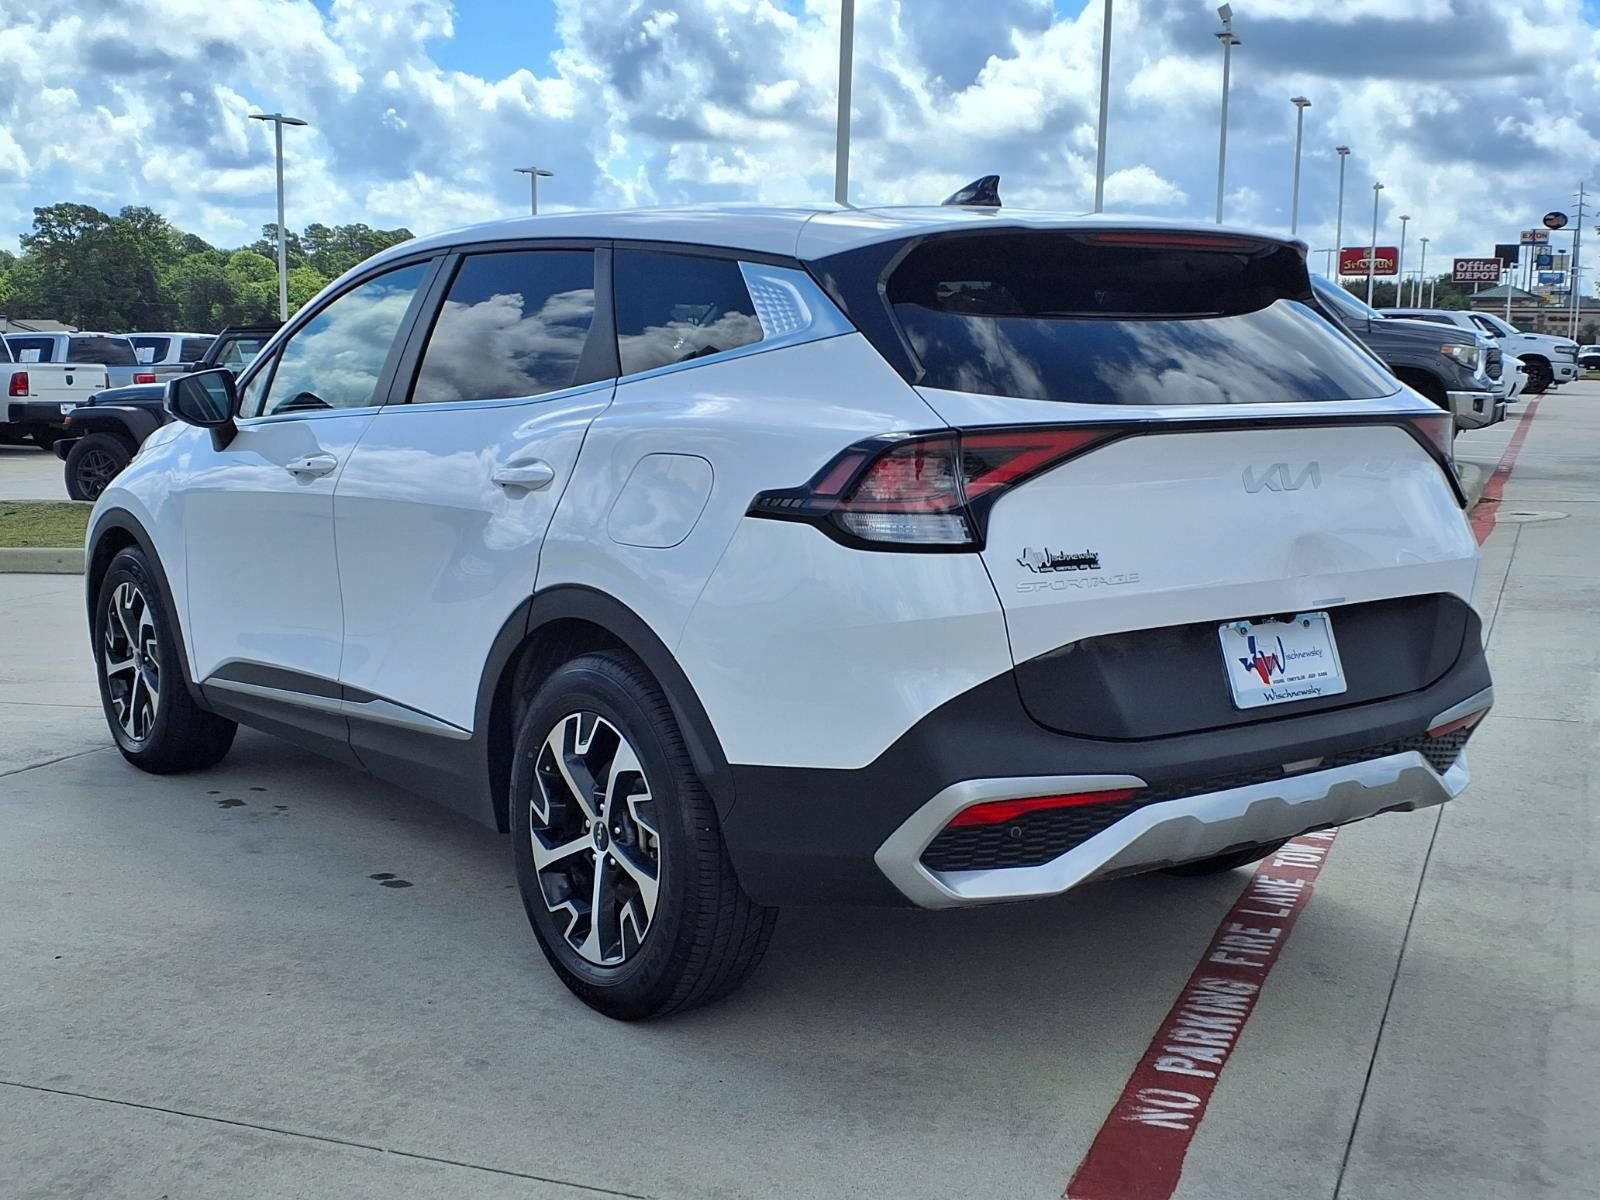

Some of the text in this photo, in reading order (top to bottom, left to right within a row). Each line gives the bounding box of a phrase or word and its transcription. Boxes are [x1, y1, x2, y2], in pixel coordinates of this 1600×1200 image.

[1455, 271, 1498, 280] DEPOT
[1456, 260, 1498, 271] Office
[1016, 573, 1140, 593] SPORTAGE
[1263, 686, 1321, 701] Wischnewsky
[1272, 842, 1327, 868] TOW
[1238, 875, 1305, 918] LANE
[1210, 922, 1282, 967] FIRE
[1153, 977, 1260, 1078] PARKING
[1121, 1087, 1201, 1130] NO
